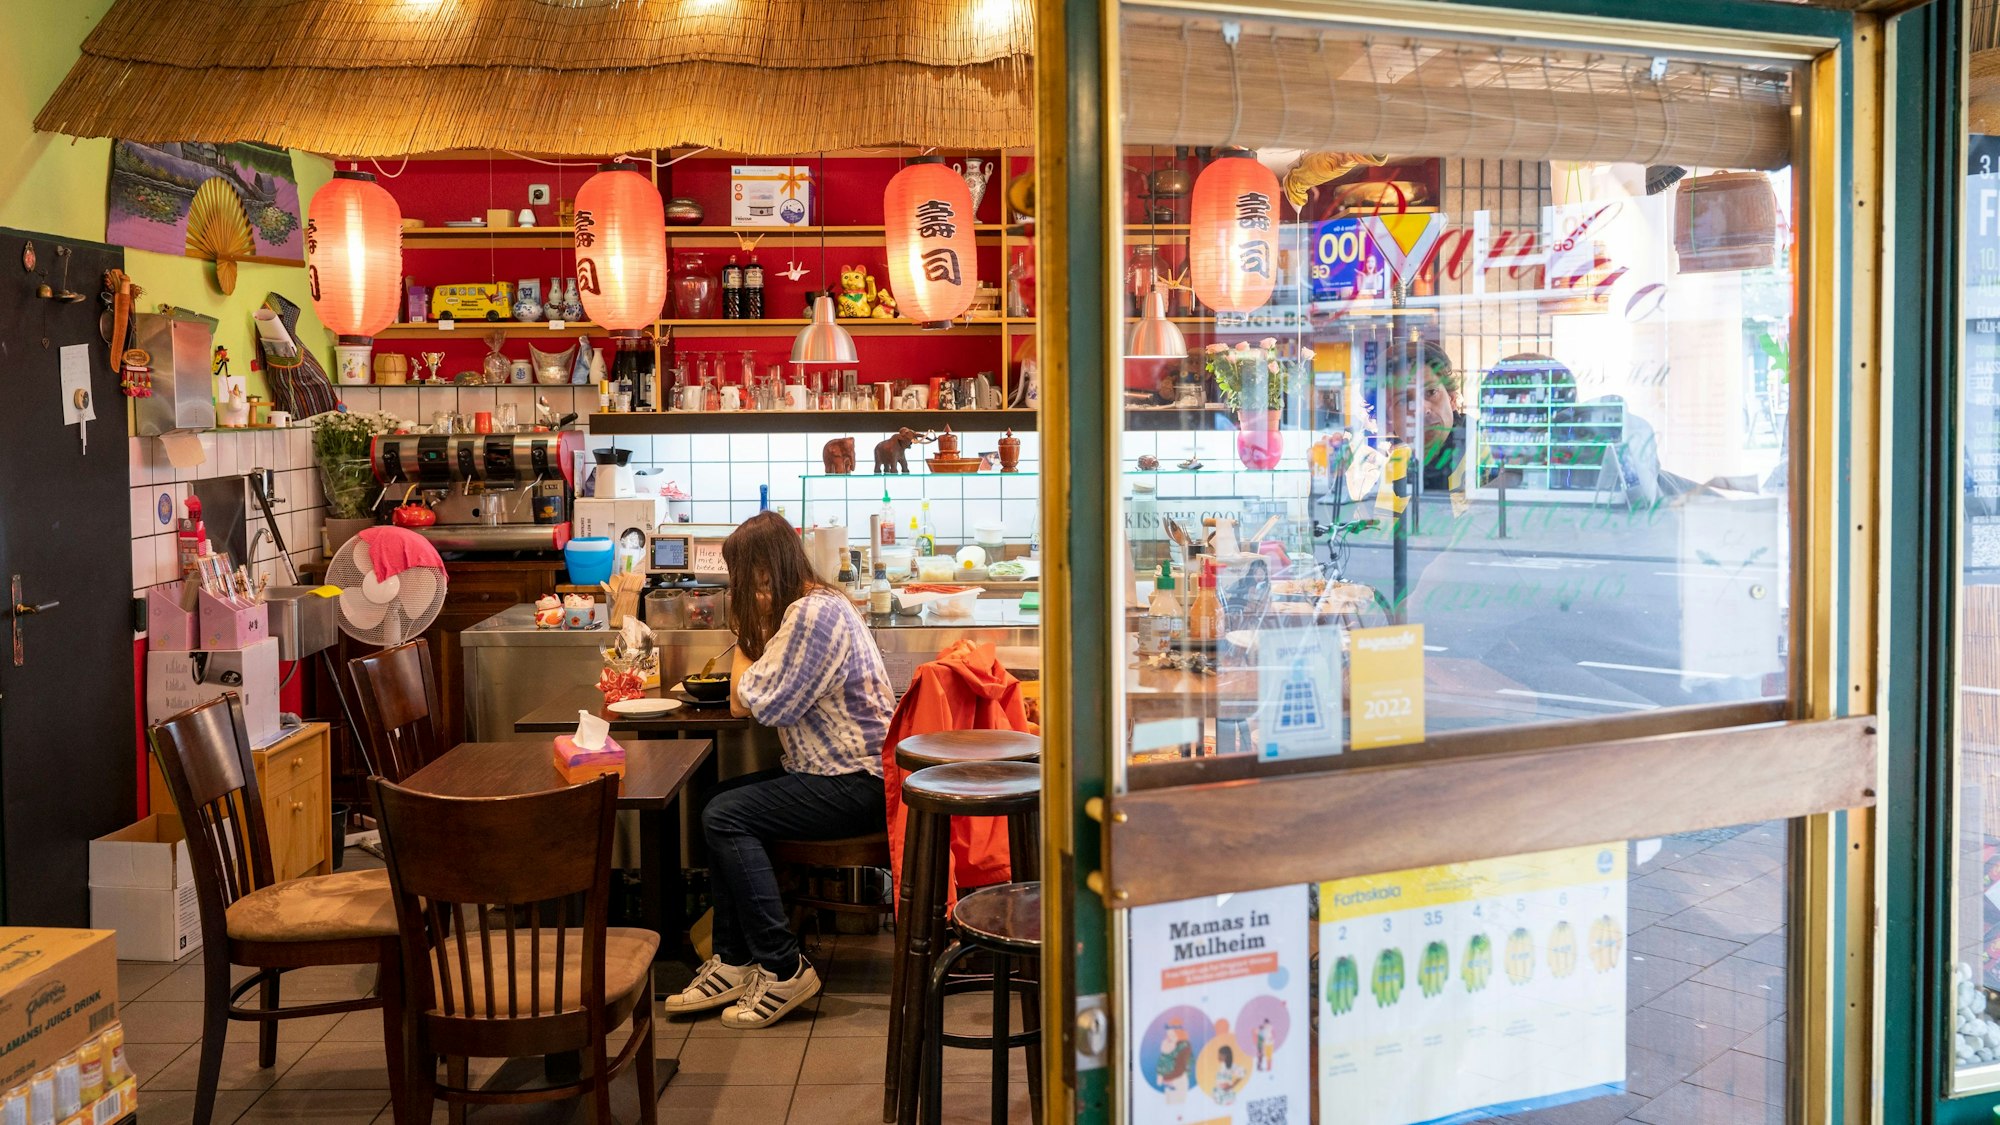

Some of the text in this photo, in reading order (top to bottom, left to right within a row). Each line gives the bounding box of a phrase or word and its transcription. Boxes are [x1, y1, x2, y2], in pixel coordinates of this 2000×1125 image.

[1979, 188, 2000, 236] F
[1124, 511, 1160, 529] KISS
[1364, 697, 1412, 720] 2022
[1333, 884, 1402, 907] Farbskala
[1424, 909, 1444, 927] 3.5
[1473, 904, 1482, 918] 4
[1169, 910, 1270, 941] Mamas in
[1338, 926, 1348, 941] 2
[1382, 917, 1393, 933] 3
[45, 1007, 72, 1030] JUICE
[74, 989, 102, 1014] DRINK
